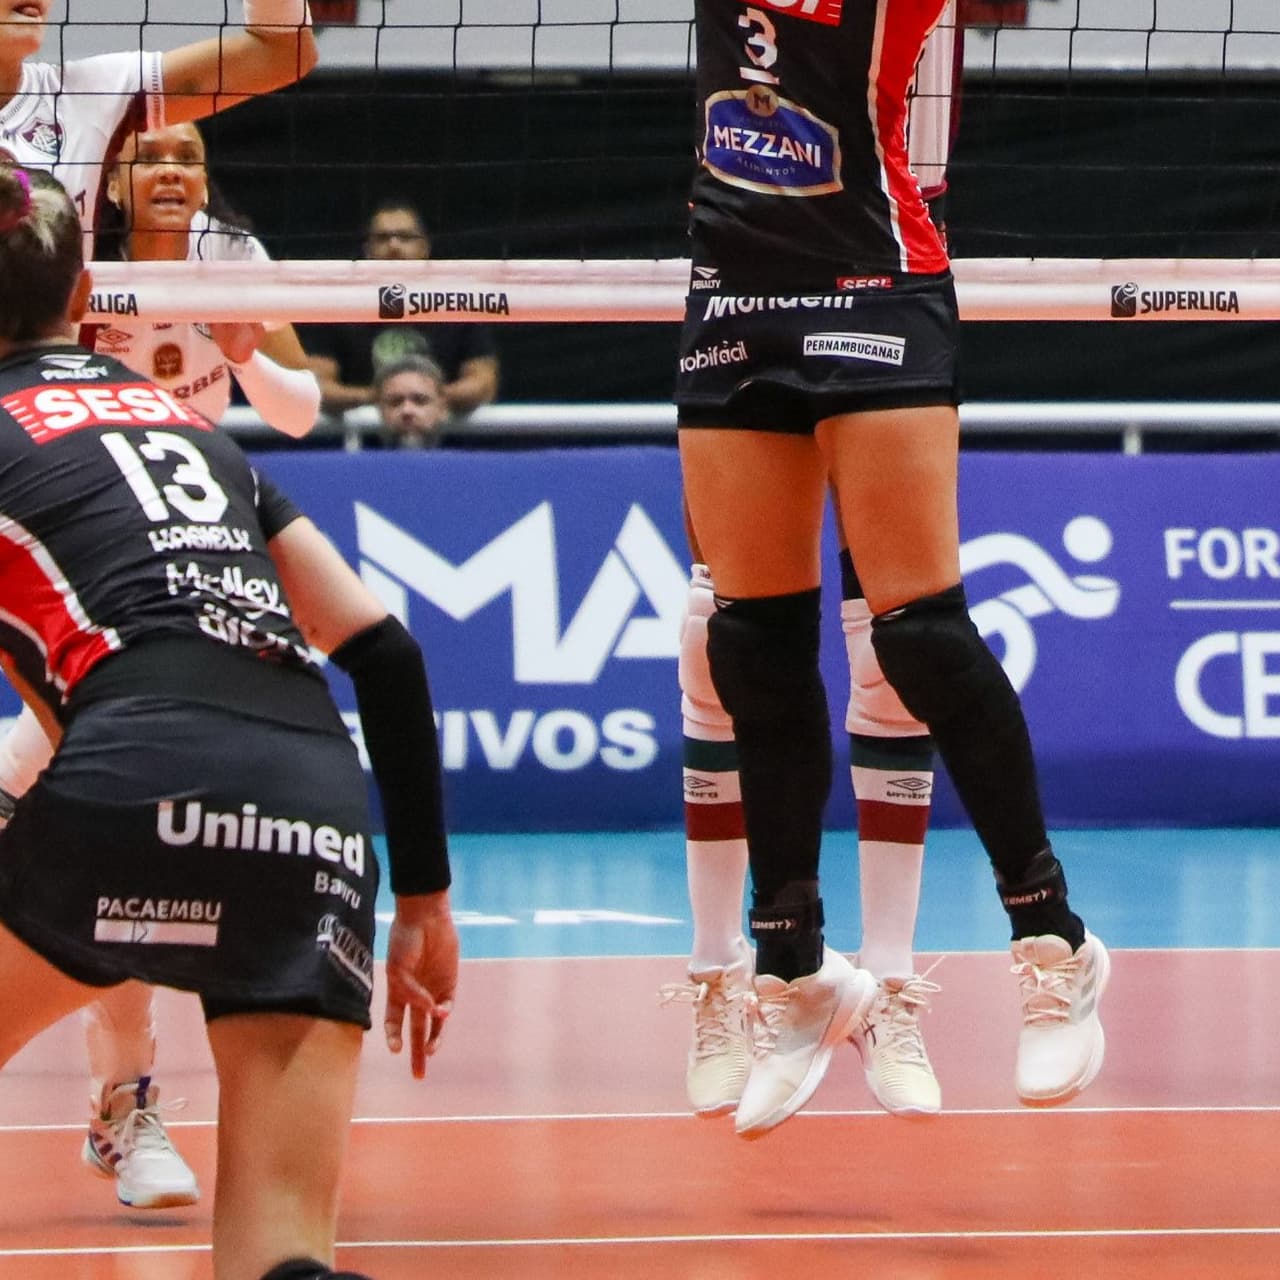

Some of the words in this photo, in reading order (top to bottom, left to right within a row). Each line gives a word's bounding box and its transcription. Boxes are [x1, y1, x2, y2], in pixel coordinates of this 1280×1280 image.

[738, 8, 780, 84] 3
[713, 124, 821, 168] MEZZANI
[88, 293, 138, 316] RLIGA
[408, 291, 509, 316] SUPERLIGA
[1140, 290, 1239, 315] SUPERLIGA
[806, 339, 901, 361] PERNAMBUCANAS
[33, 387, 190, 429] SESI
[100, 432, 228, 525] 13
[156, 800, 366, 877] Unimed
[96, 897, 221, 923] PACAEMBU
